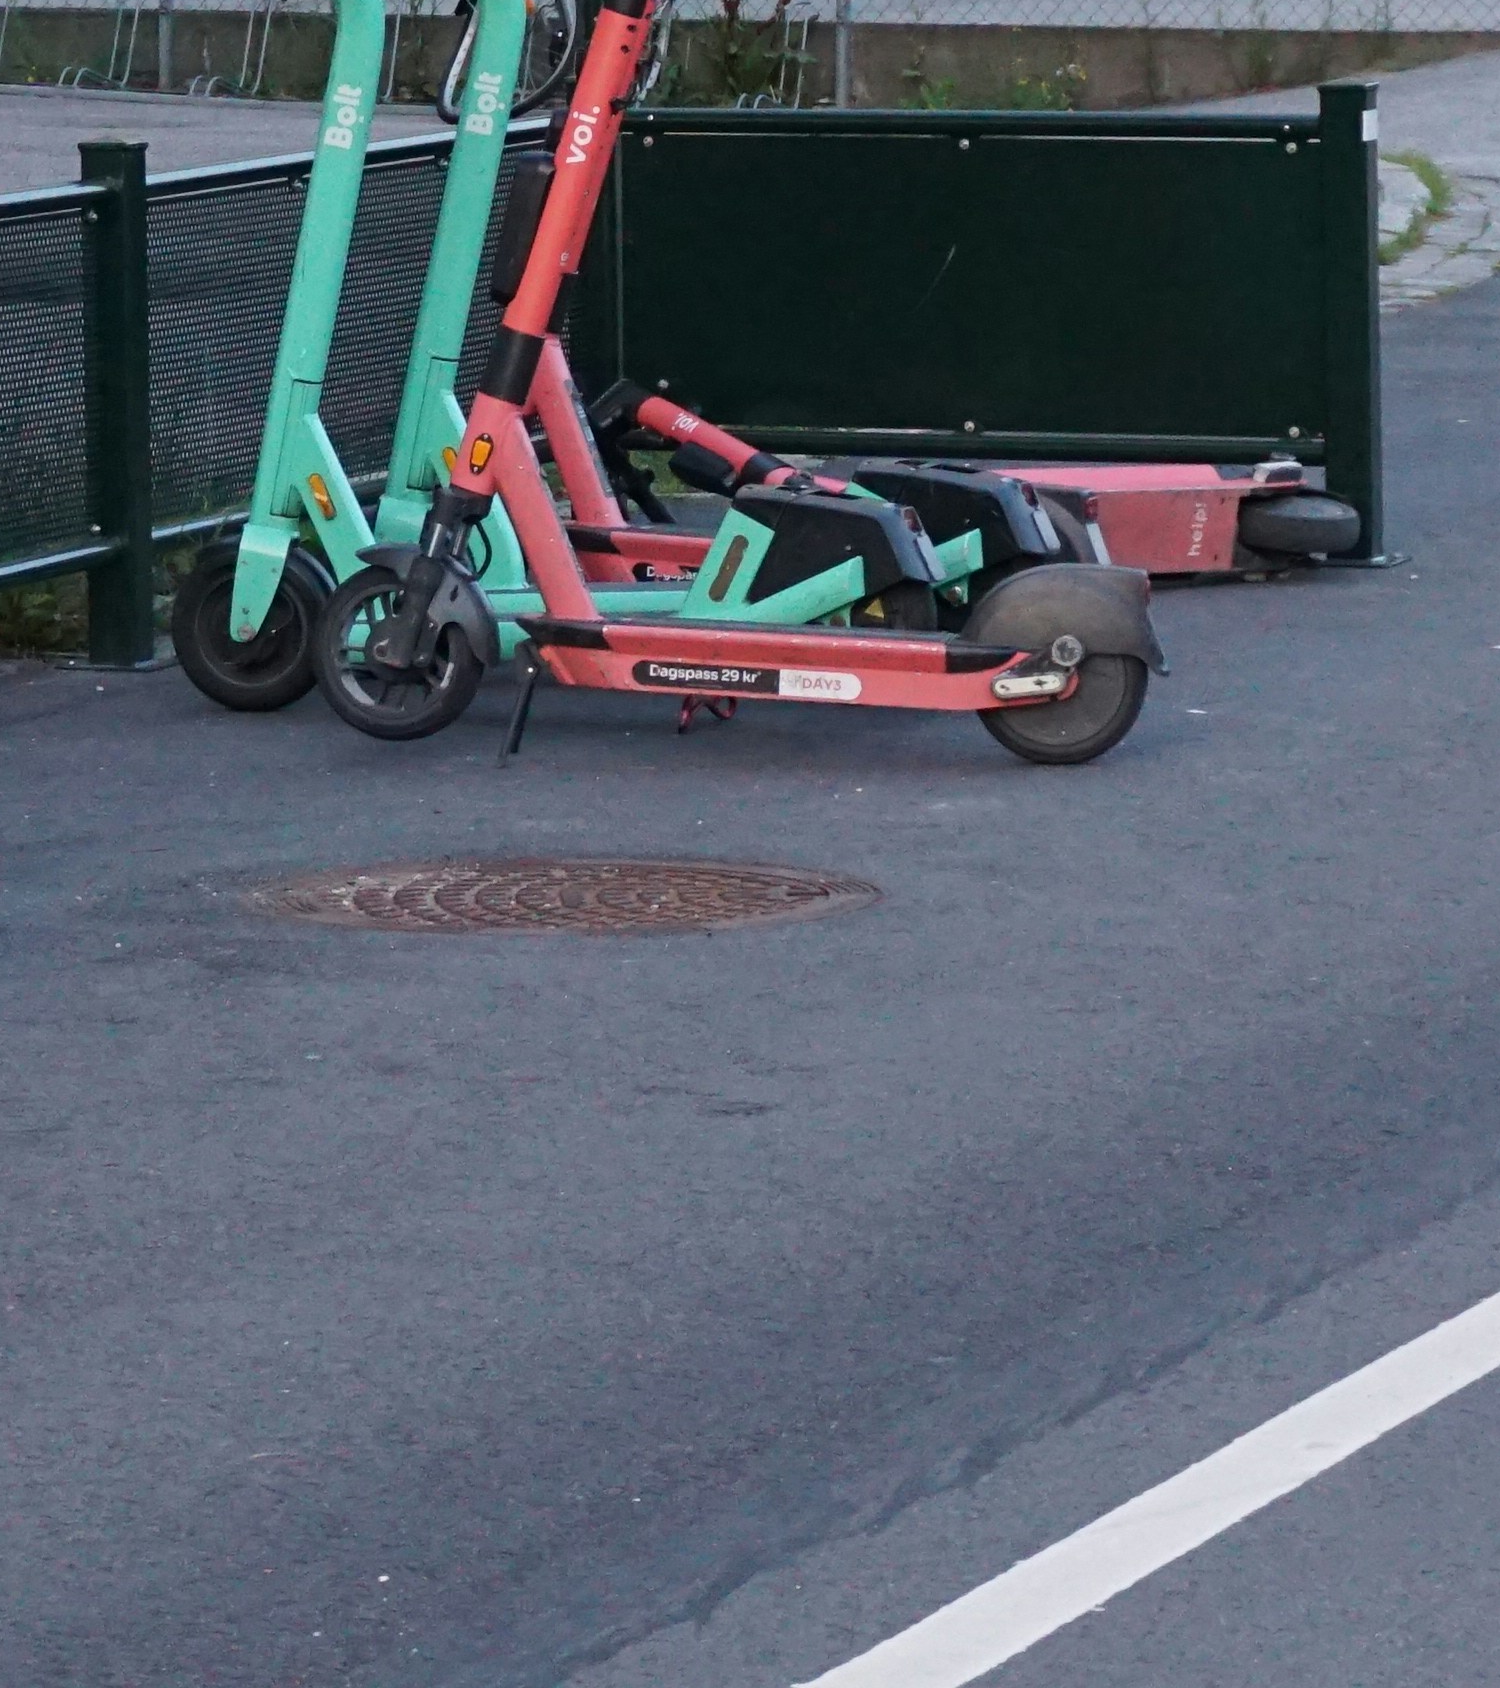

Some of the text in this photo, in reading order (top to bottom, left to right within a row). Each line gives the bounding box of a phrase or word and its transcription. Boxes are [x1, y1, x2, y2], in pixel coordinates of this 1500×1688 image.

[324, 84, 364, 150] Bolt
[465, 71, 505, 135] Bolt
[649, 663, 718, 682] Dagspass
[721, 669, 739, 682] 29
